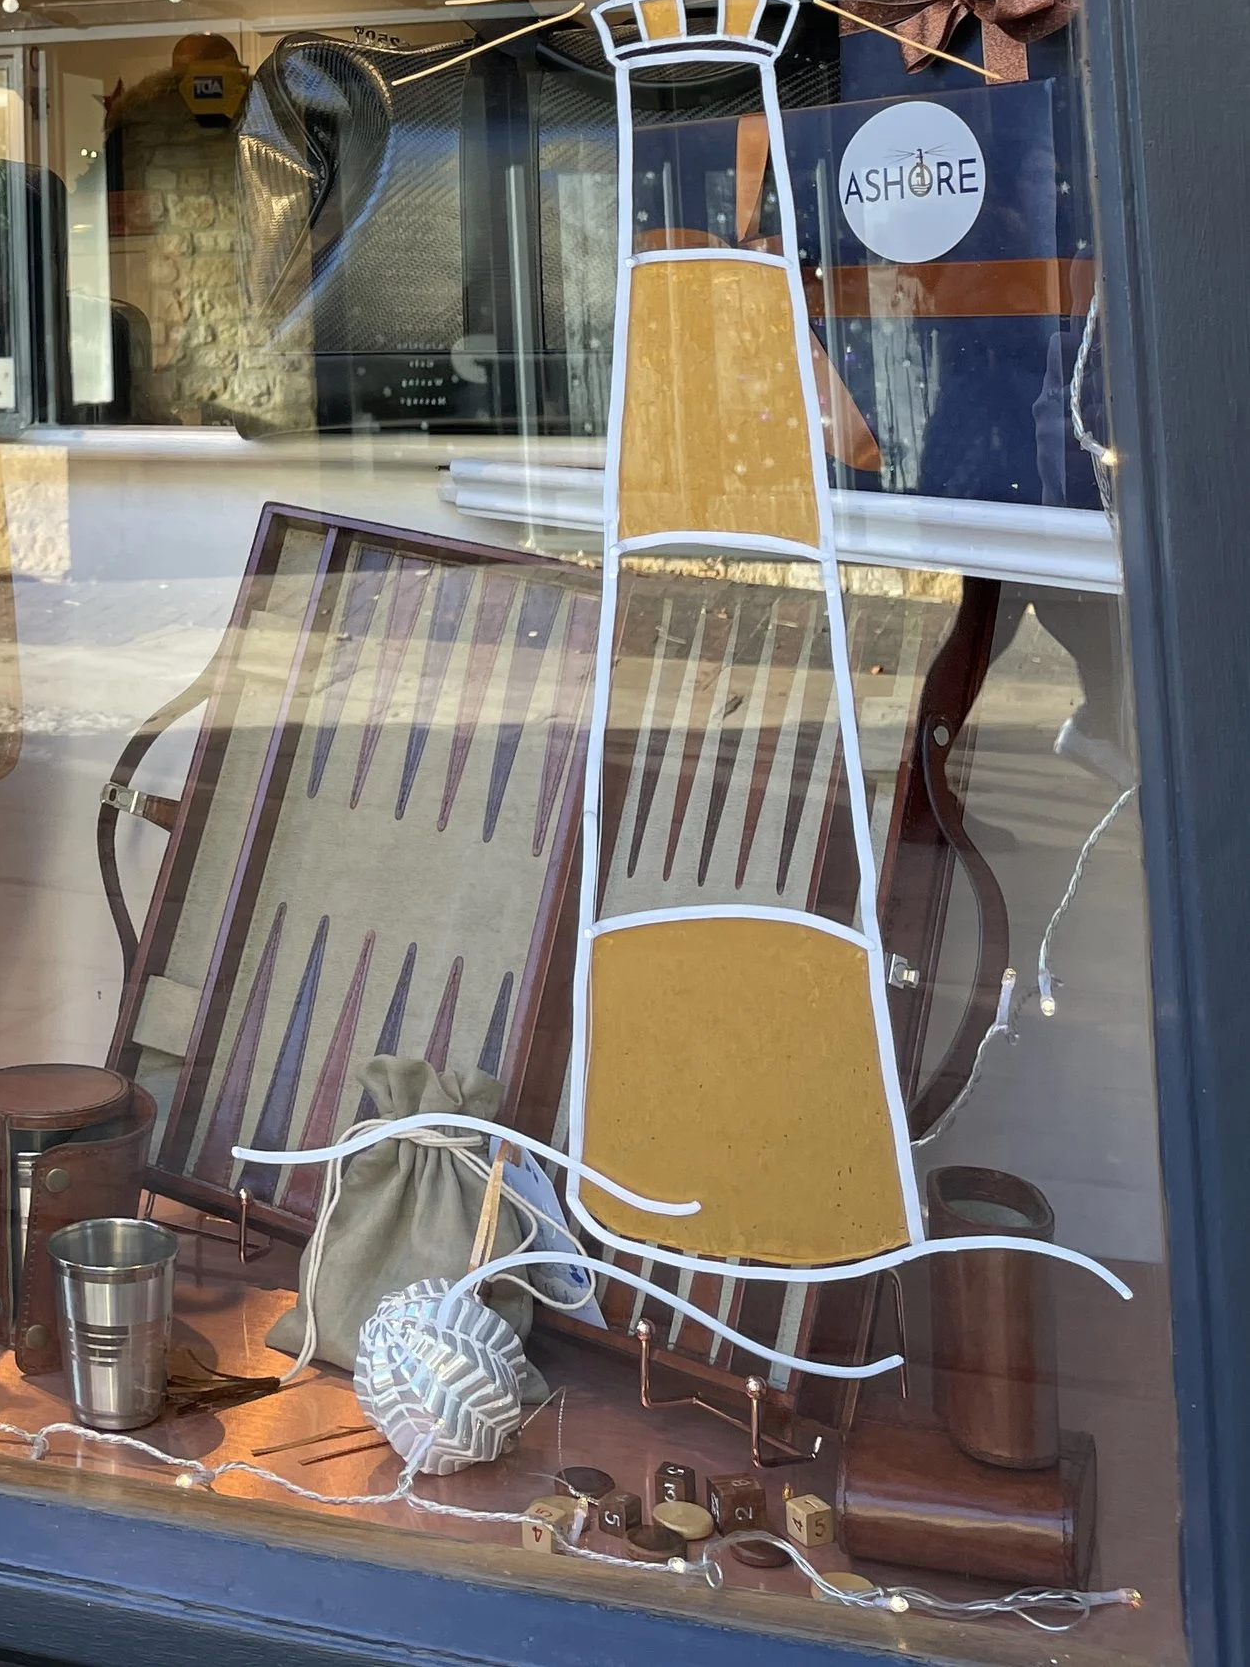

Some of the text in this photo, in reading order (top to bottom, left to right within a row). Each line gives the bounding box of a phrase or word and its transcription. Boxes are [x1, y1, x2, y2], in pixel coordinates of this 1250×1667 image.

[844, 154, 980, 205] ASHORE
[604, 1510, 621, 1527] 5
[735, 1506, 754, 1521] 2
[531, 1525, 543, 1543] 4
[814, 1518, 827, 1537] 5
